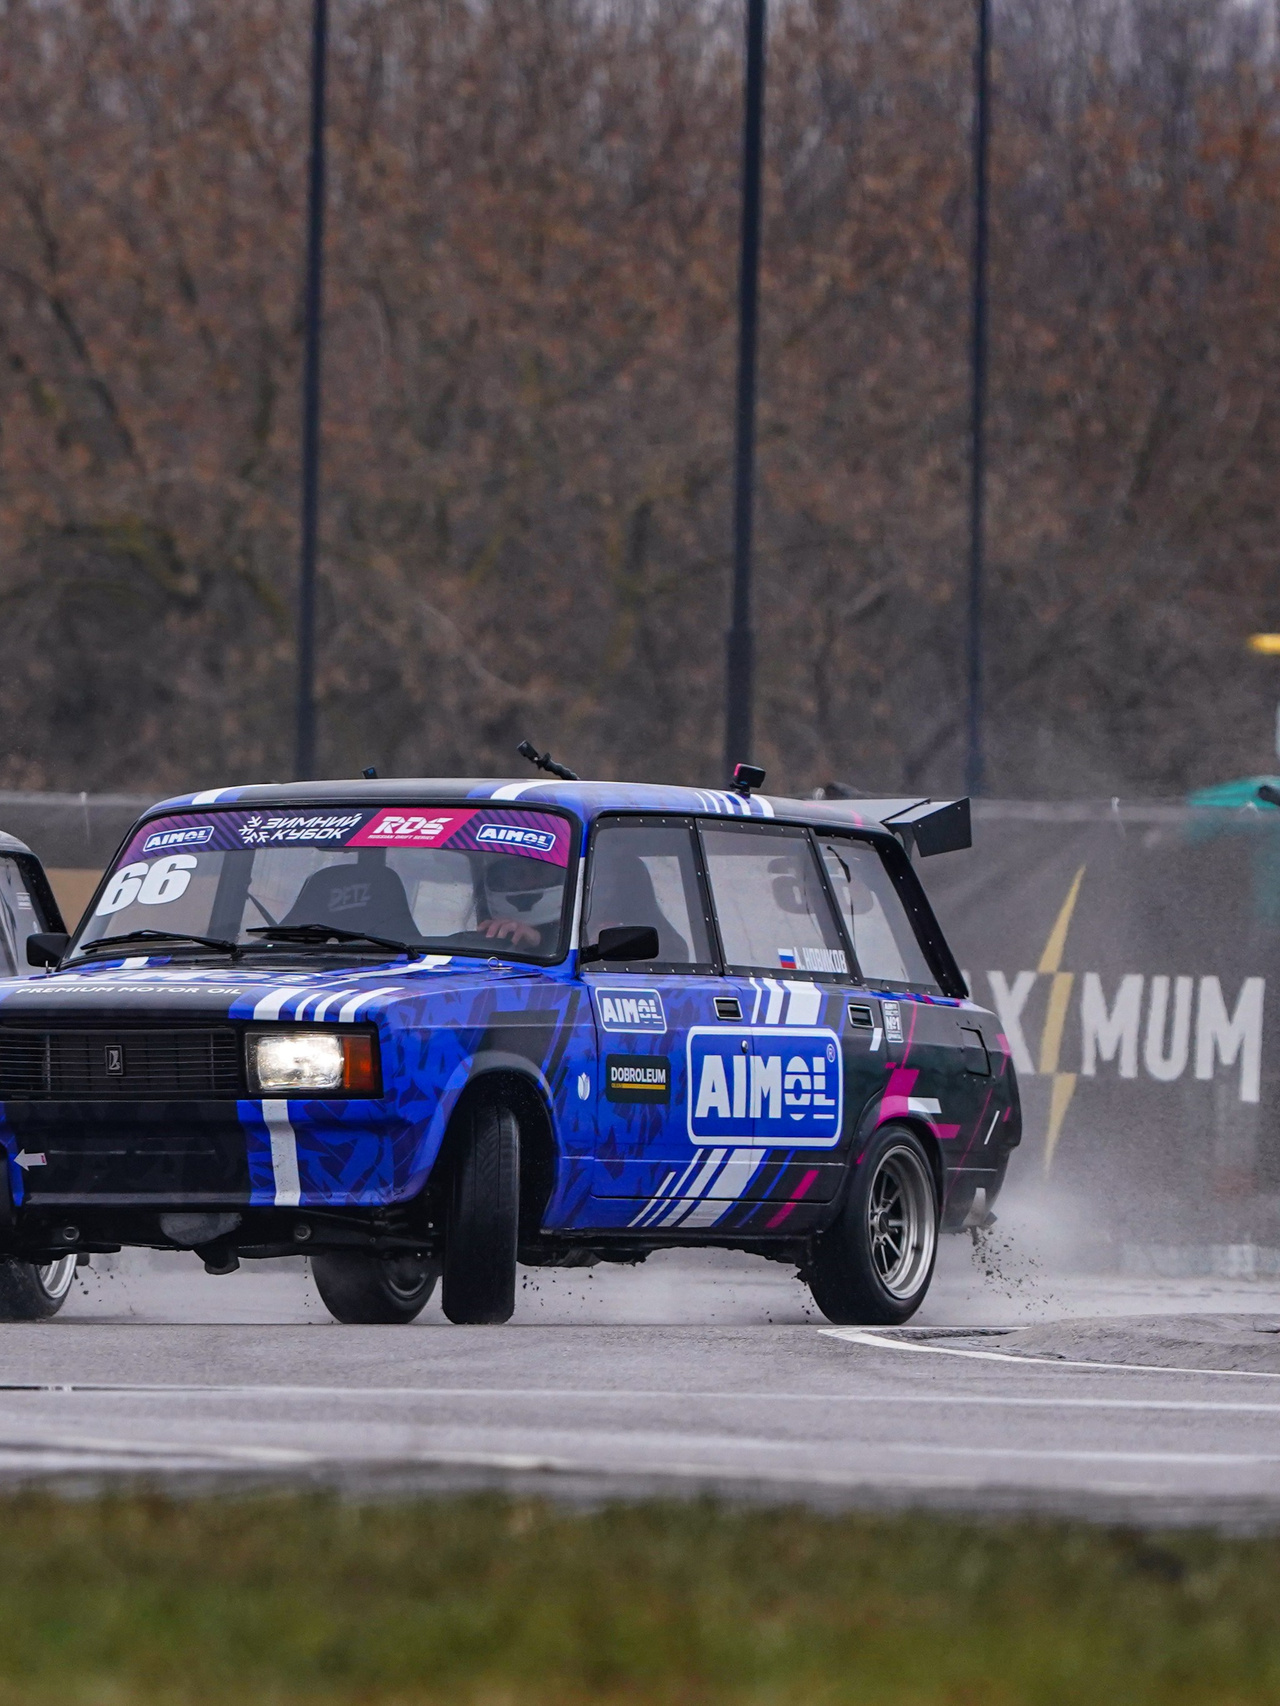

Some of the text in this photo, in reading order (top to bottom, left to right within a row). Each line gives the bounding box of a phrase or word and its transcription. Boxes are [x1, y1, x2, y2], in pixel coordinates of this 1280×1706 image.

[261, 813, 363, 829] ЗИМНИЙ
[373, 816, 454, 835] RDS
[147, 829, 209, 849] AIMOL
[271, 828, 351, 840] КУБОК
[480, 828, 549, 847] AIMOL
[95, 854, 198, 917] 66
[16, 986, 242, 995] PREMIUM MOTOR OIL
[603, 997, 663, 1025] AIMOL
[611, 1066, 666, 1084] DOBROLEUM
